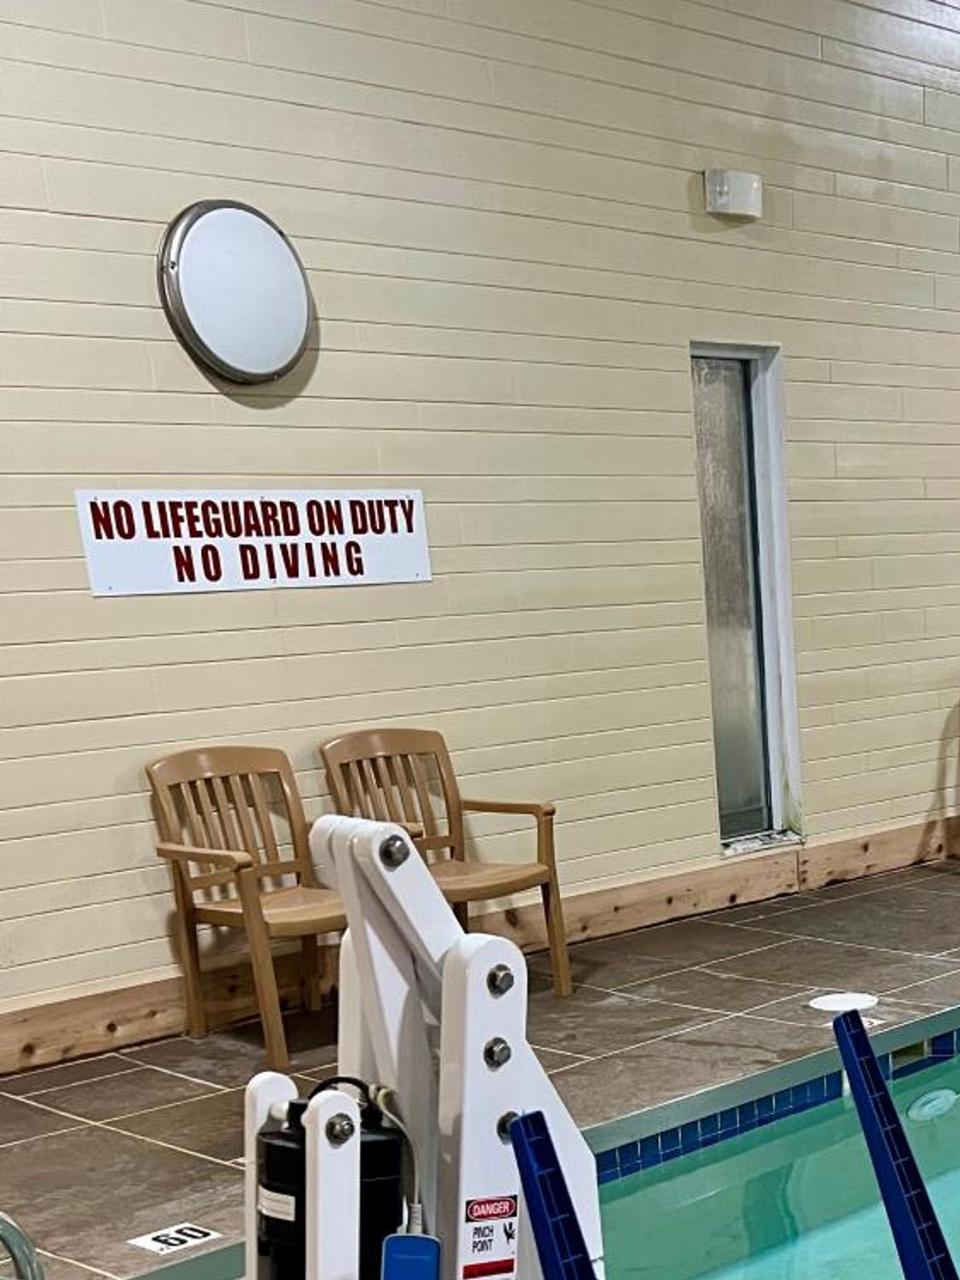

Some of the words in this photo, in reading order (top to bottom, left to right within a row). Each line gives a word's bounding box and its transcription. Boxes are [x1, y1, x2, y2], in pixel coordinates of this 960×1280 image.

[90, 500, 136, 540] NO
[141, 500, 301, 539] LIFEGUARD
[306, 499, 345, 537] ON
[349, 499, 415, 535] DUTY
[172, 544, 223, 582] NO
[239, 541, 365, 580] DIVING
[473, 1201, 510, 1216] DANGER
[472, 1225, 494, 1239] PINCH
[472, 1239, 494, 1253] POINT
